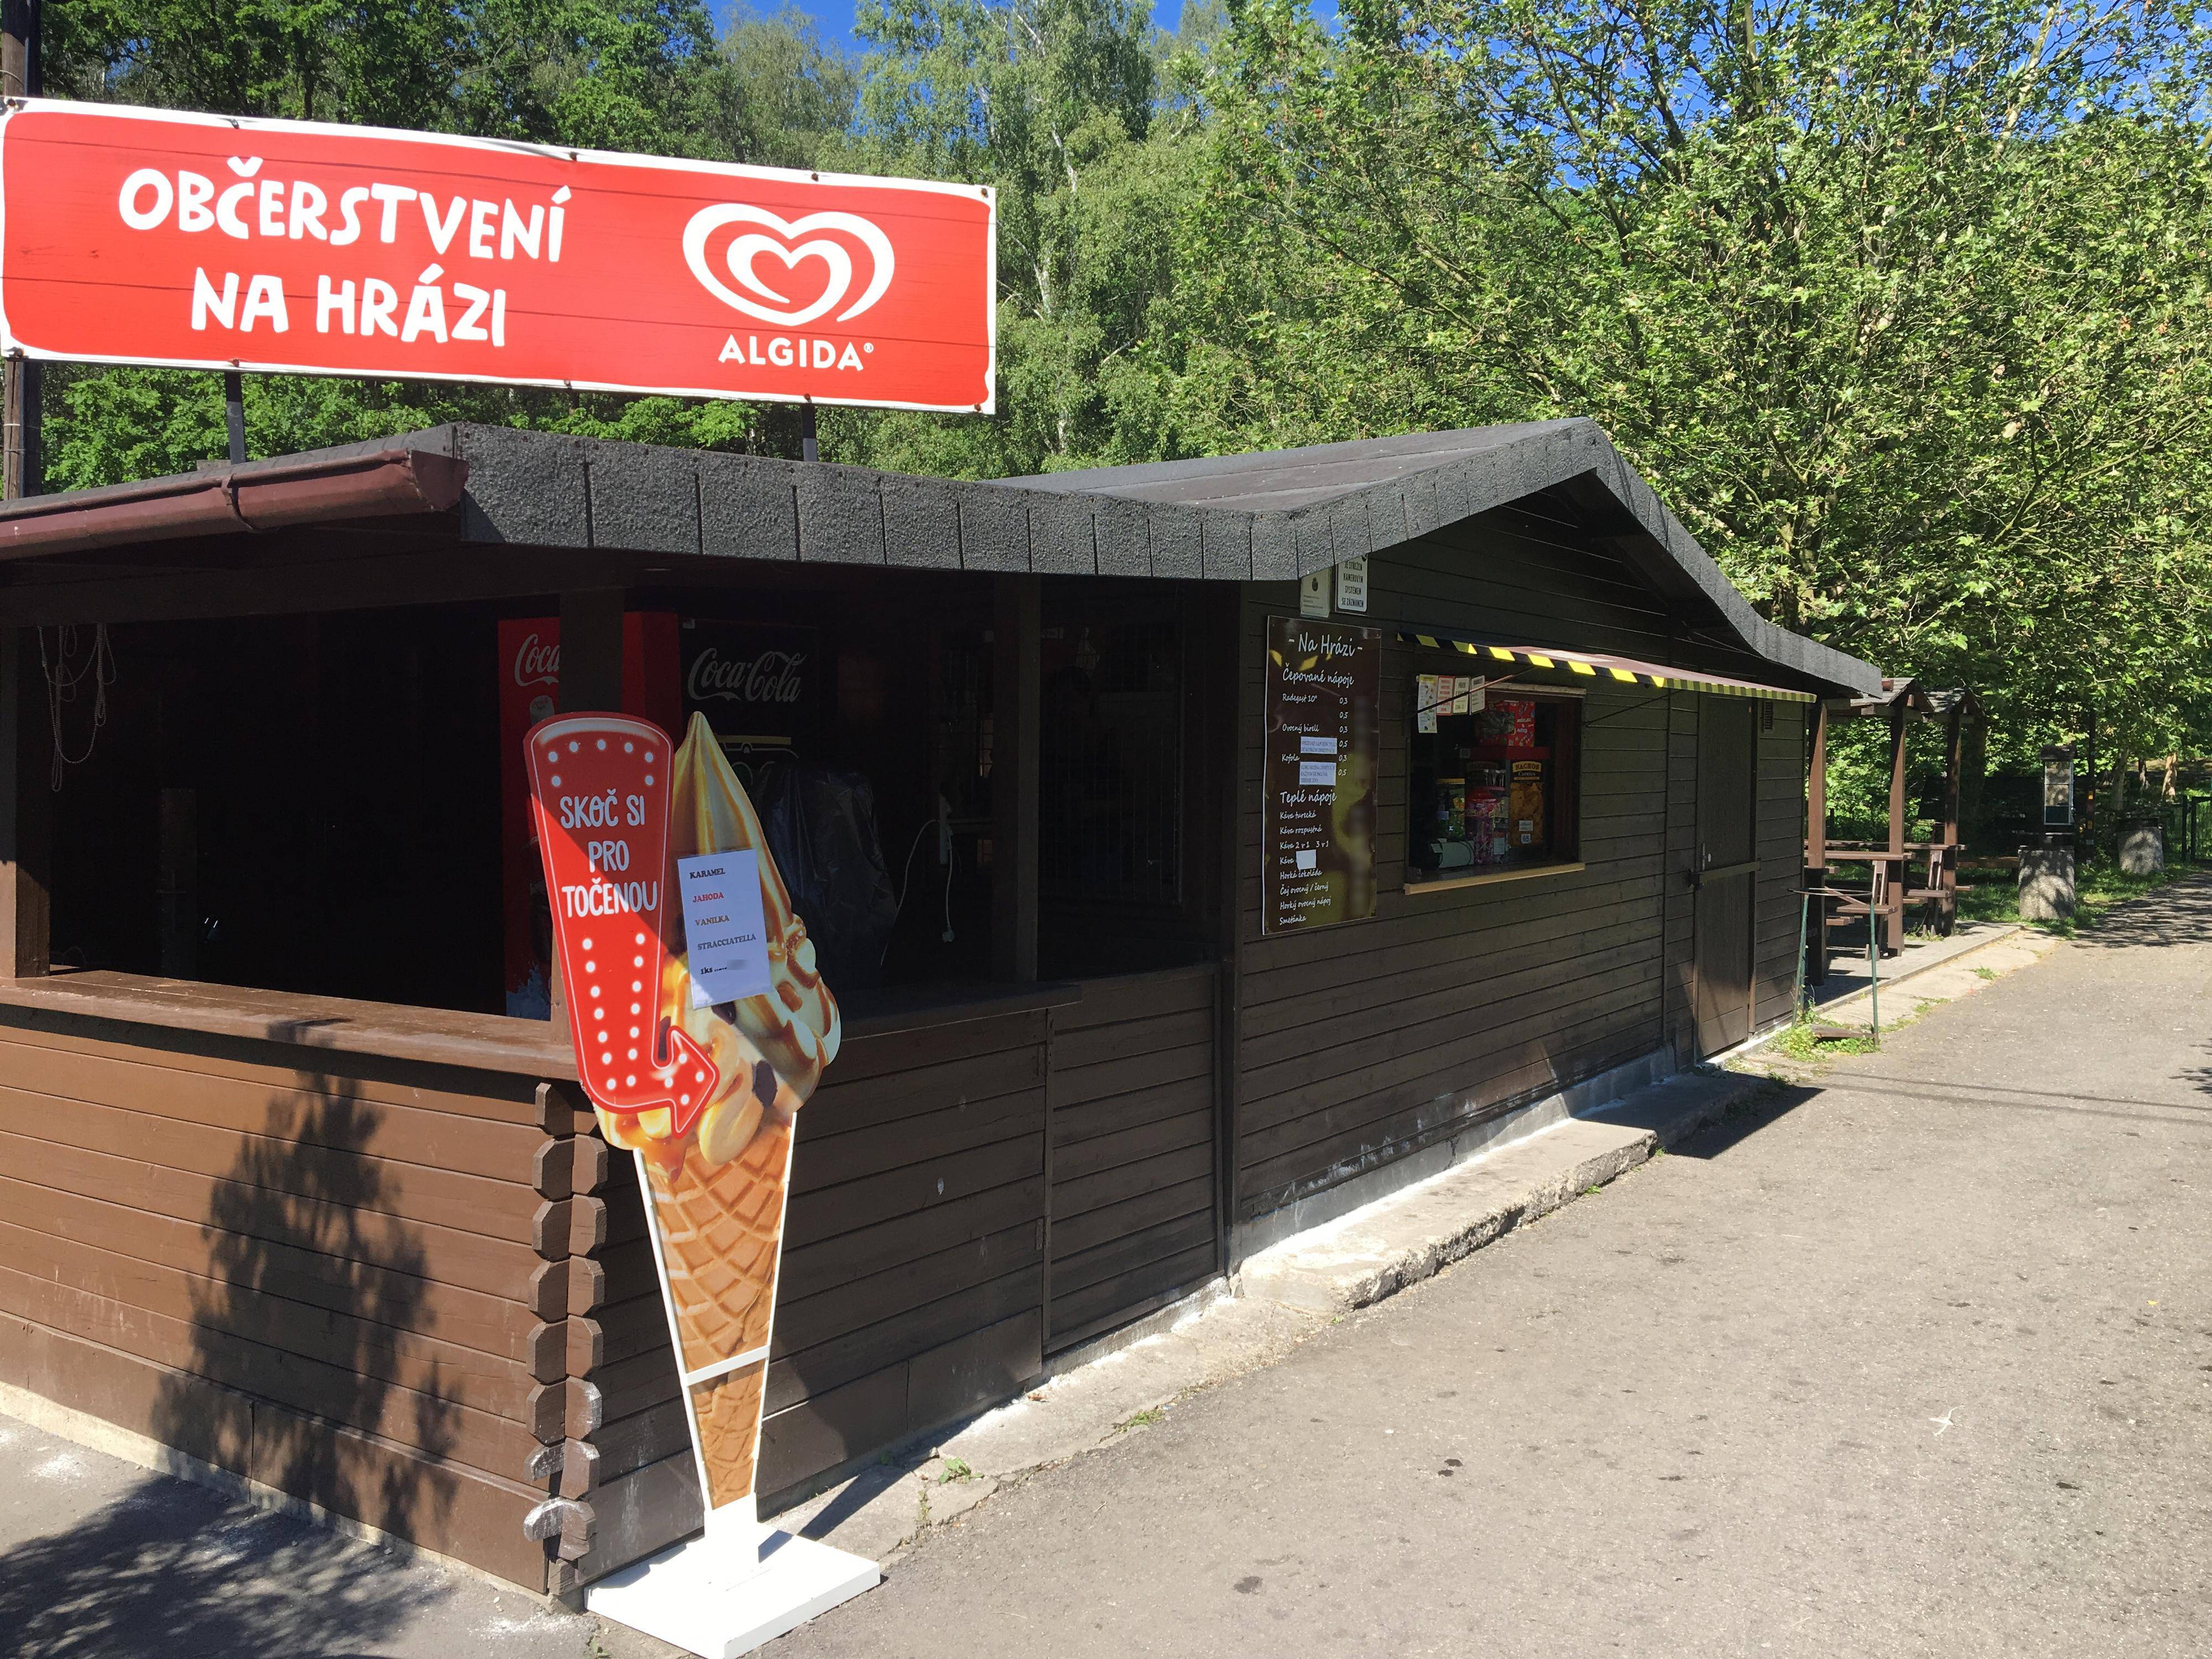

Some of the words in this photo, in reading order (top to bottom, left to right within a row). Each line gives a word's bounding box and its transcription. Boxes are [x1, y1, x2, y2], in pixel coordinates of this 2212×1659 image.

[119, 156, 572, 263] OBČERSTVENÍ
[191, 267, 289, 333] NA
[316, 263, 506, 347] HRÁZI
[1343, 573, 1363, 583] KAMEROVÝM
[1342, 597, 1347, 606] SE
[1347, 597, 1364, 608] ZÁZNAMEM
[1298, 632, 1318, 652] Na
[1321, 634, 1355, 656] Hrázi
[687, 647, 807, 702] Coca-Cola
[1282, 662, 1326, 685] Čepované
[1327, 671, 1354, 688] nápoje
[1282, 693, 1307, 703] Radegast
[1282, 723, 1302, 733] Ovocný
[1282, 754, 1300, 762] Kofola
[1280, 790, 1306, 807] Teplé
[1308, 789, 1337, 806] nápoje
[560, 789, 619, 829] SKOČ
[627, 795, 645, 825] SI
[1280, 811, 1295, 820] Káva
[1295, 810, 1317, 819] turecká
[1280, 826, 1295, 834] Káva
[1295, 824, 1323, 835] rozpustná
[1280, 841, 1295, 849] Káva
[588, 841, 629, 873] PRO
[1280, 856, 1295, 865] Káva
[690, 868, 726, 879] KARAMEL
[1280, 870, 1298, 880] Horká
[1298, 868, 1323, 878] čokoláda
[1280, 884, 1289, 896] Čaj
[1290, 884, 1309, 894] ovocný
[1314, 881, 1329, 891] černý
[561, 877, 658, 917] TOČENOU
[692, 892, 724, 902] JAHODA
[1280, 900, 1297, 910] Horký
[1297, 898, 1317, 908] ovocný
[1317, 895, 1332, 906] nápoj
[695, 915, 730, 926] VANILKA
[1279, 914, 1307, 925] Smetánka
[697, 933, 757, 951] STRACCIATELLA
